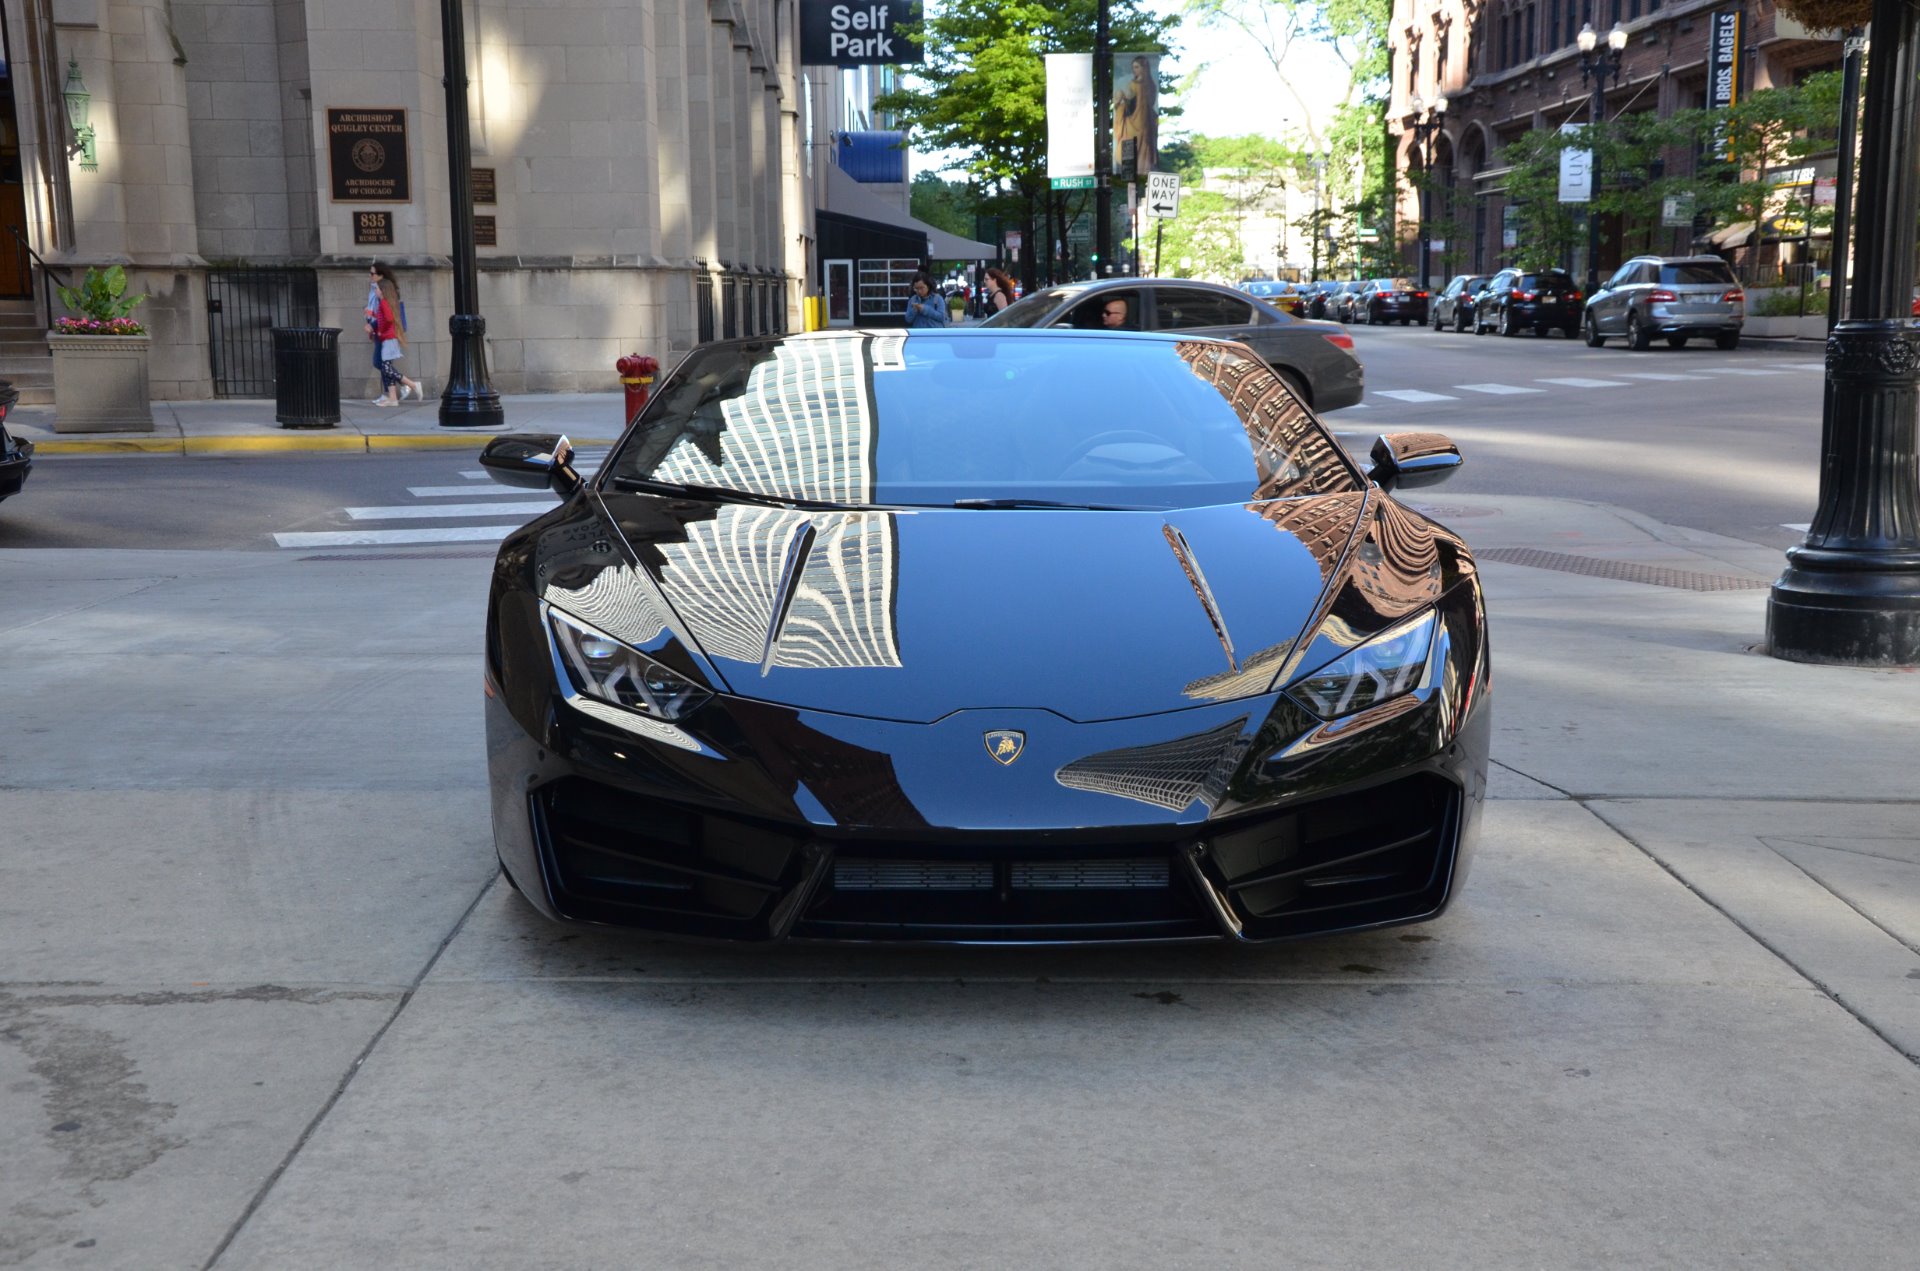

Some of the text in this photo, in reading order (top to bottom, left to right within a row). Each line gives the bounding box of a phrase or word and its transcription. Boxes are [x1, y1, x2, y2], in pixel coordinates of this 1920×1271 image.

[831, 5, 888, 31] Self
[1718, 14, 1735, 62] BAGELS
[831, 32, 894, 57] Park
[340, 114, 394, 122] ARCHBISHOP
[331, 124, 403, 133] QUIGLEY CENTER
[345, 179, 396, 187] ARCHDIOCESE
[1060, 176, 1084, 187] RUSH
[1152, 177, 1177, 189] ONE
[1151, 189, 1176, 200] WAY
[360, 213, 385, 228] 835
